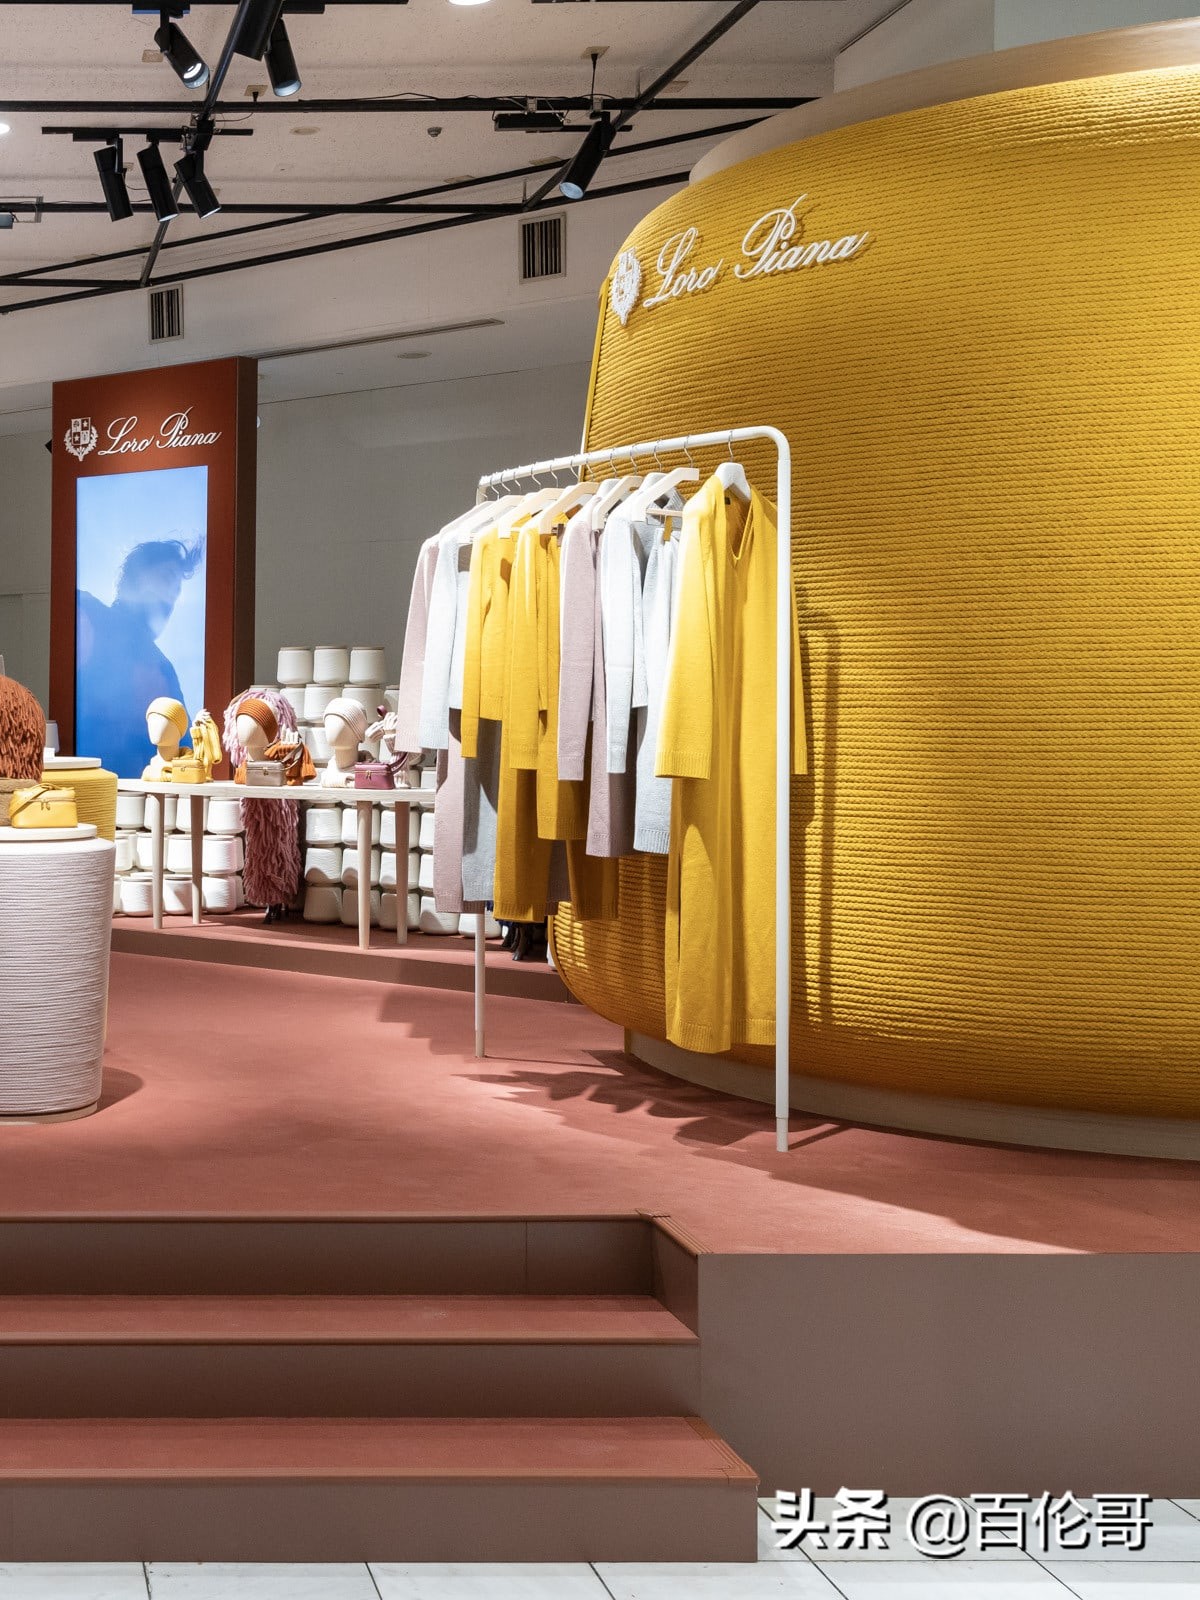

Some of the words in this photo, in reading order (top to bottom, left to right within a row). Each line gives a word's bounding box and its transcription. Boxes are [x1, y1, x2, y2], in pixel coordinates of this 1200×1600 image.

[643, 227, 724, 308] Loro
[735, 193, 869, 279] Piana
[97, 416, 154, 456] Loro
[156, 406, 222, 449] Piana
